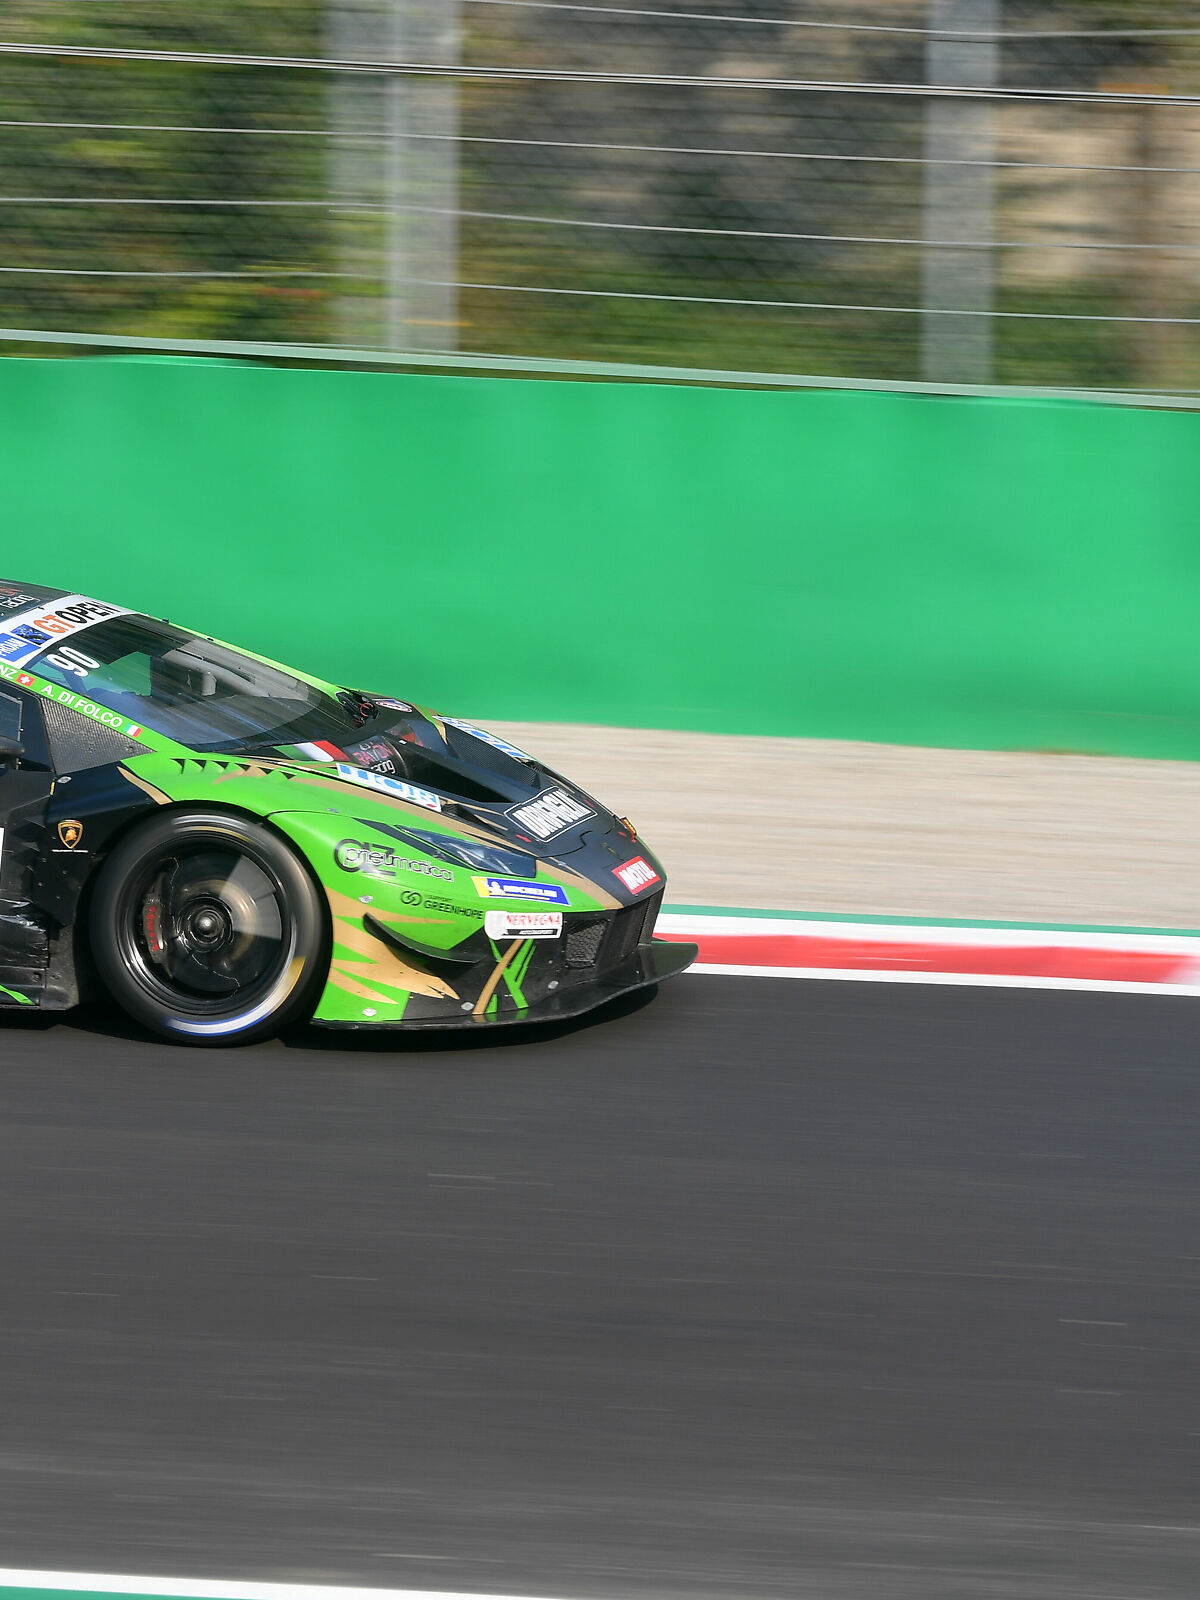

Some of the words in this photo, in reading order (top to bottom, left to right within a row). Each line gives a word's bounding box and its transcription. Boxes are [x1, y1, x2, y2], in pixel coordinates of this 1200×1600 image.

[46, 646, 100, 677] 90
[41, 685, 55, 698] A.
[58, 691, 76, 705] DI
[75, 699, 123, 728] FOLCO
[342, 847, 455, 882] pneumatica
[618, 860, 657, 890] MOTUL
[506, 914, 560, 926] NERVEGNA
